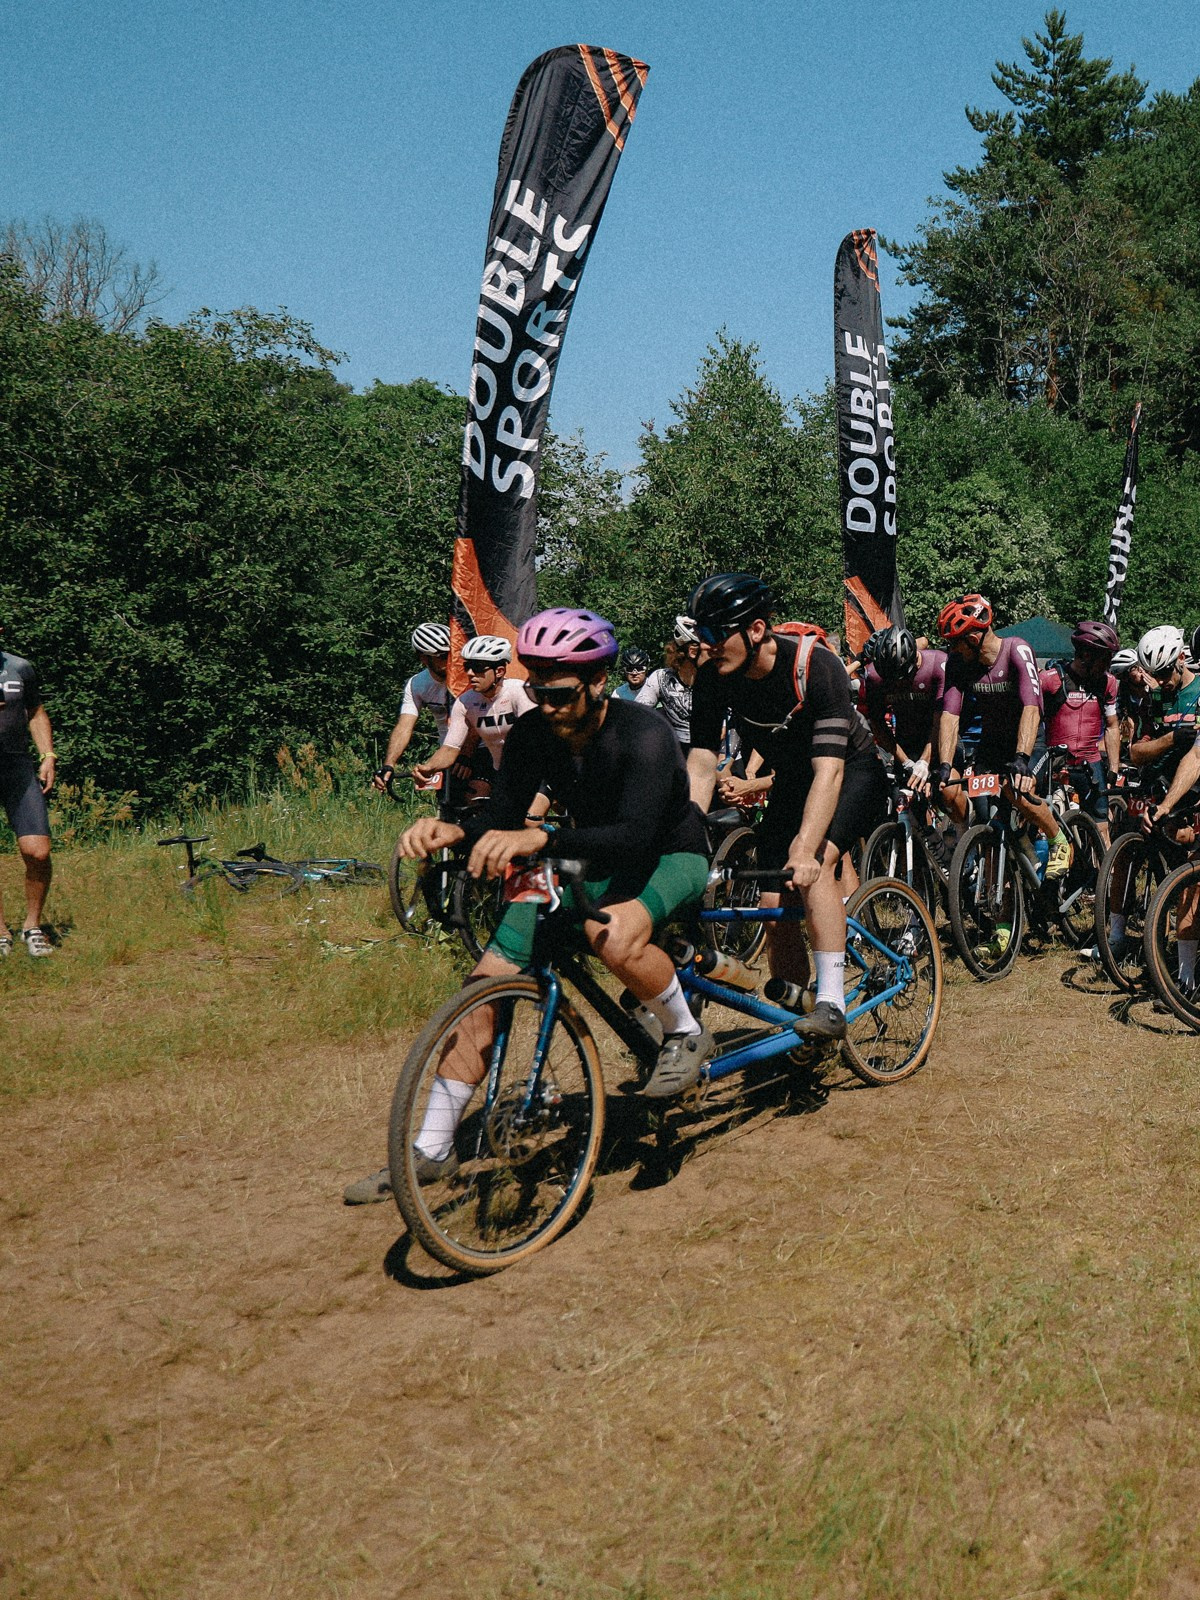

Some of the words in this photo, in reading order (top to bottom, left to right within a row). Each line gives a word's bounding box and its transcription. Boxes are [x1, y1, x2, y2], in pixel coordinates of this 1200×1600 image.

[462, 179, 549, 480] DOUBLE
[492, 214, 592, 499] SPORTS
[846, 331, 879, 533] DOUBLE
[972, 776, 995, 790] 818
